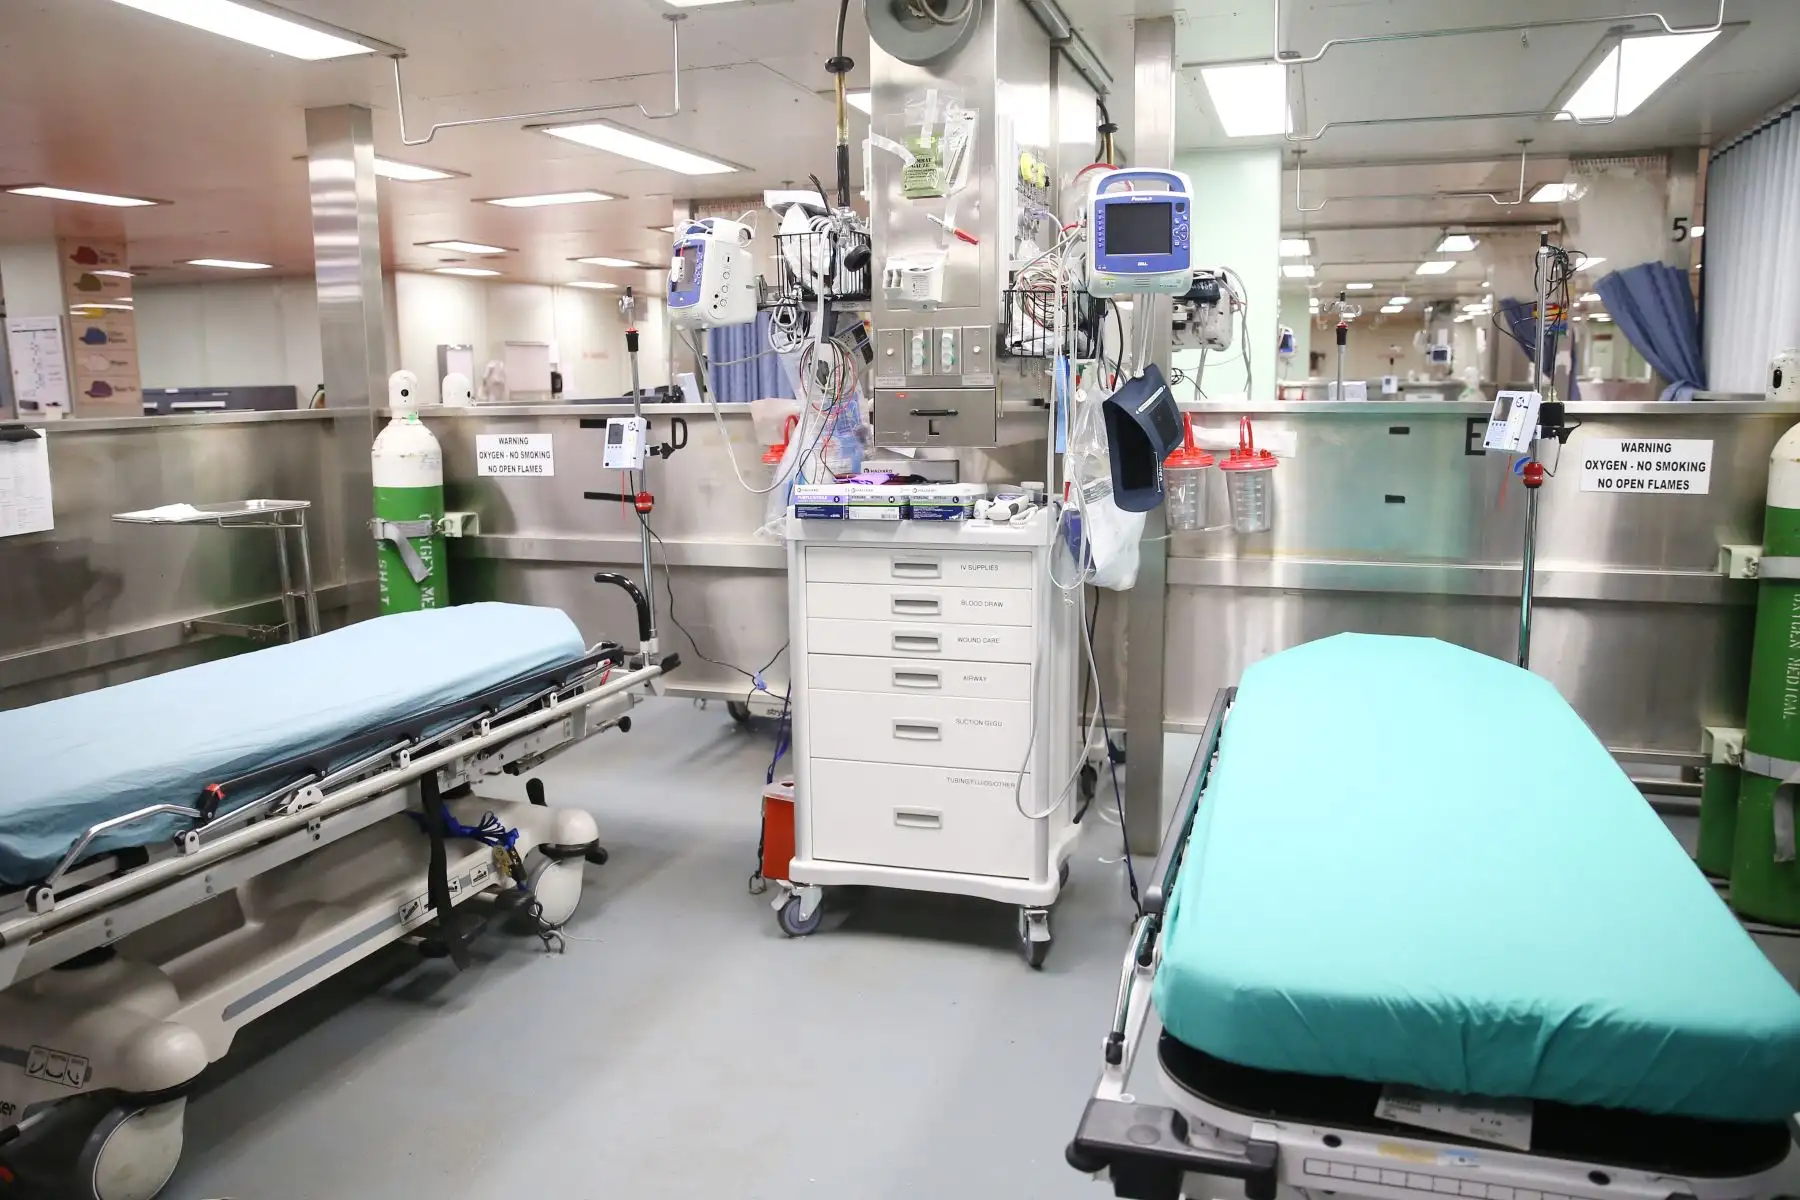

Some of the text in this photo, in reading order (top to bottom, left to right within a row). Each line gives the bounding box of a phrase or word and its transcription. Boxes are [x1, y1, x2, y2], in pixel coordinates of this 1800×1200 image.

[1672, 217, 1688, 242] 5
[672, 418, 688, 449] D
[1464, 417, 1488, 456] E
[1621, 442, 1672, 453] WARNING
[1585, 460, 1627, 470] OXYGEN
[1637, 461, 1652, 471] NO
[1655, 461, 1706, 472] SMOKING
[1598, 478, 1690, 490] NO OPEN FLAMES
